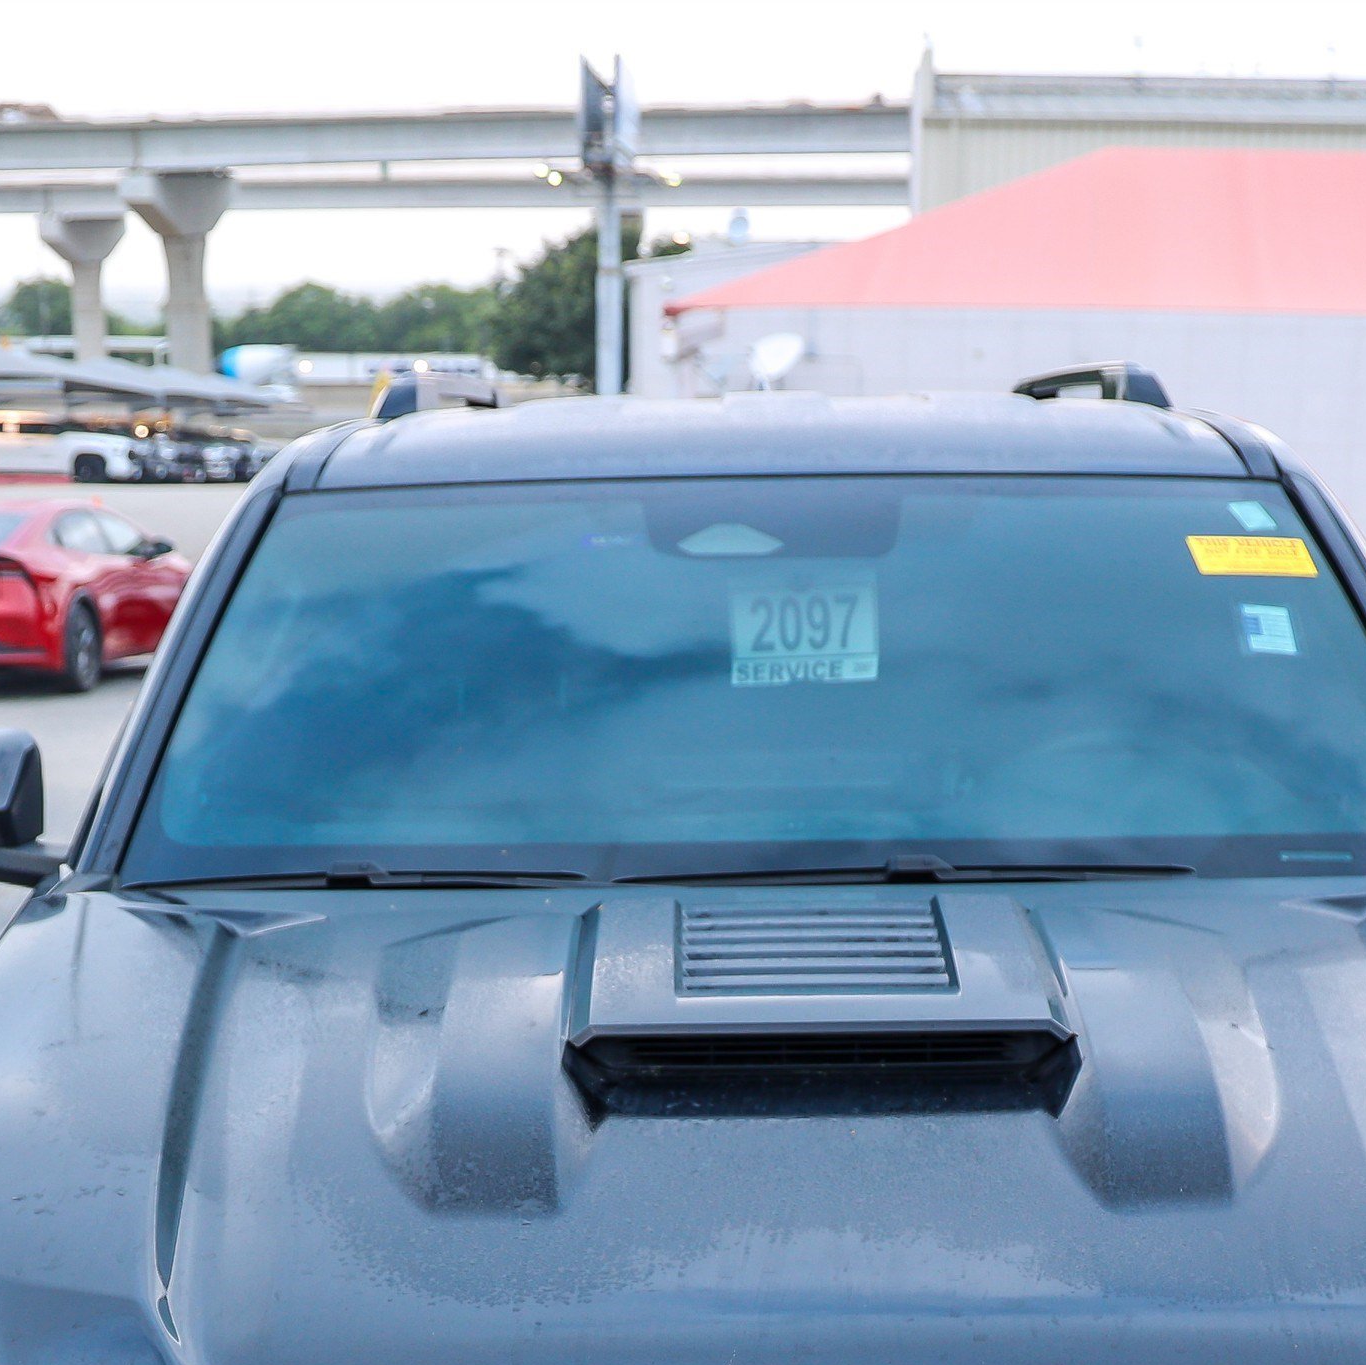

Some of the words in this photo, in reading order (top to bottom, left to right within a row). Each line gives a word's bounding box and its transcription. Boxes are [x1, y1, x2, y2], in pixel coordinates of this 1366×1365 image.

[1235, 538, 1299, 549] VEHICLE
[750, 593, 858, 651] 2097
[736, 660, 844, 682] SERVICE
